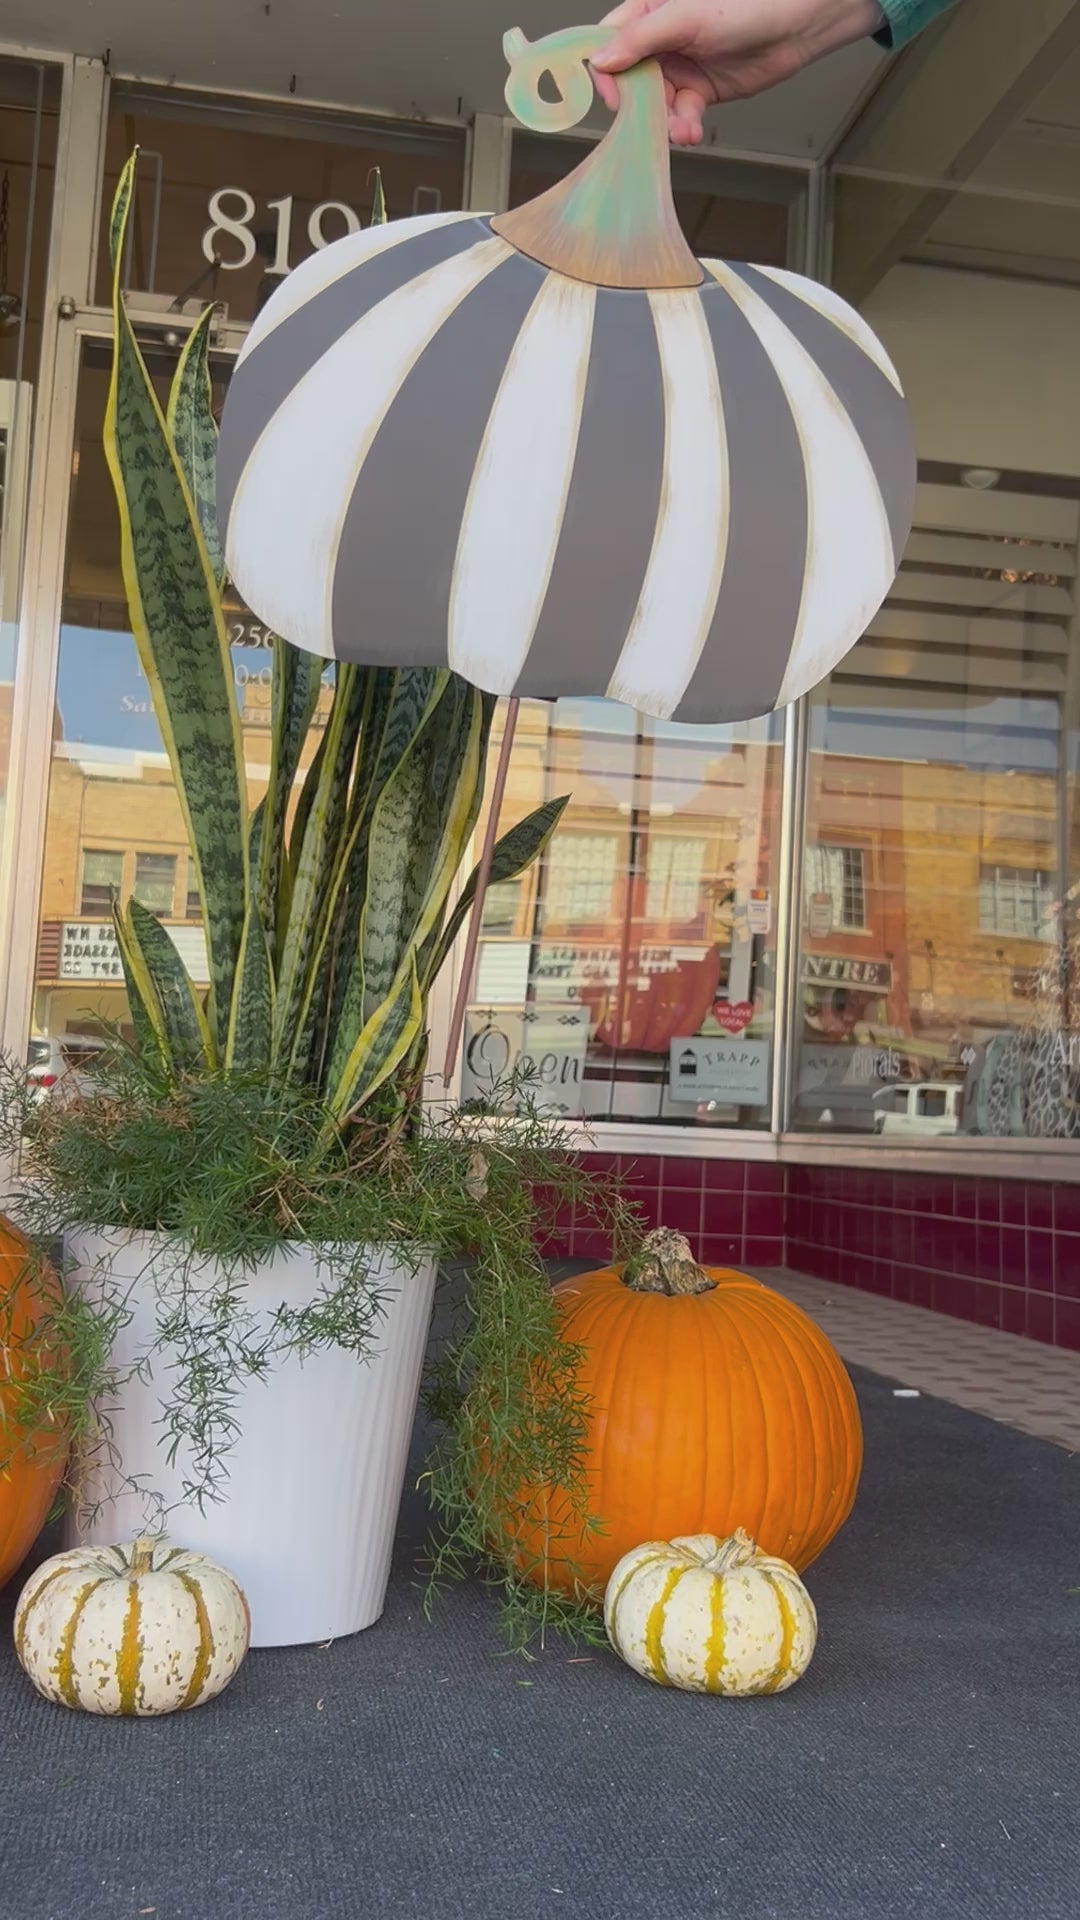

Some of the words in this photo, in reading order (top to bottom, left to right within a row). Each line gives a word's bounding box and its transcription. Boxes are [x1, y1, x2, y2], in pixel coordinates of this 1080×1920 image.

[202, 188, 361, 275] 819
[716, 1006, 730, 1015] WE
[731, 1007, 752, 1017] LOVE
[702, 1051, 761, 1067] TRAPP
